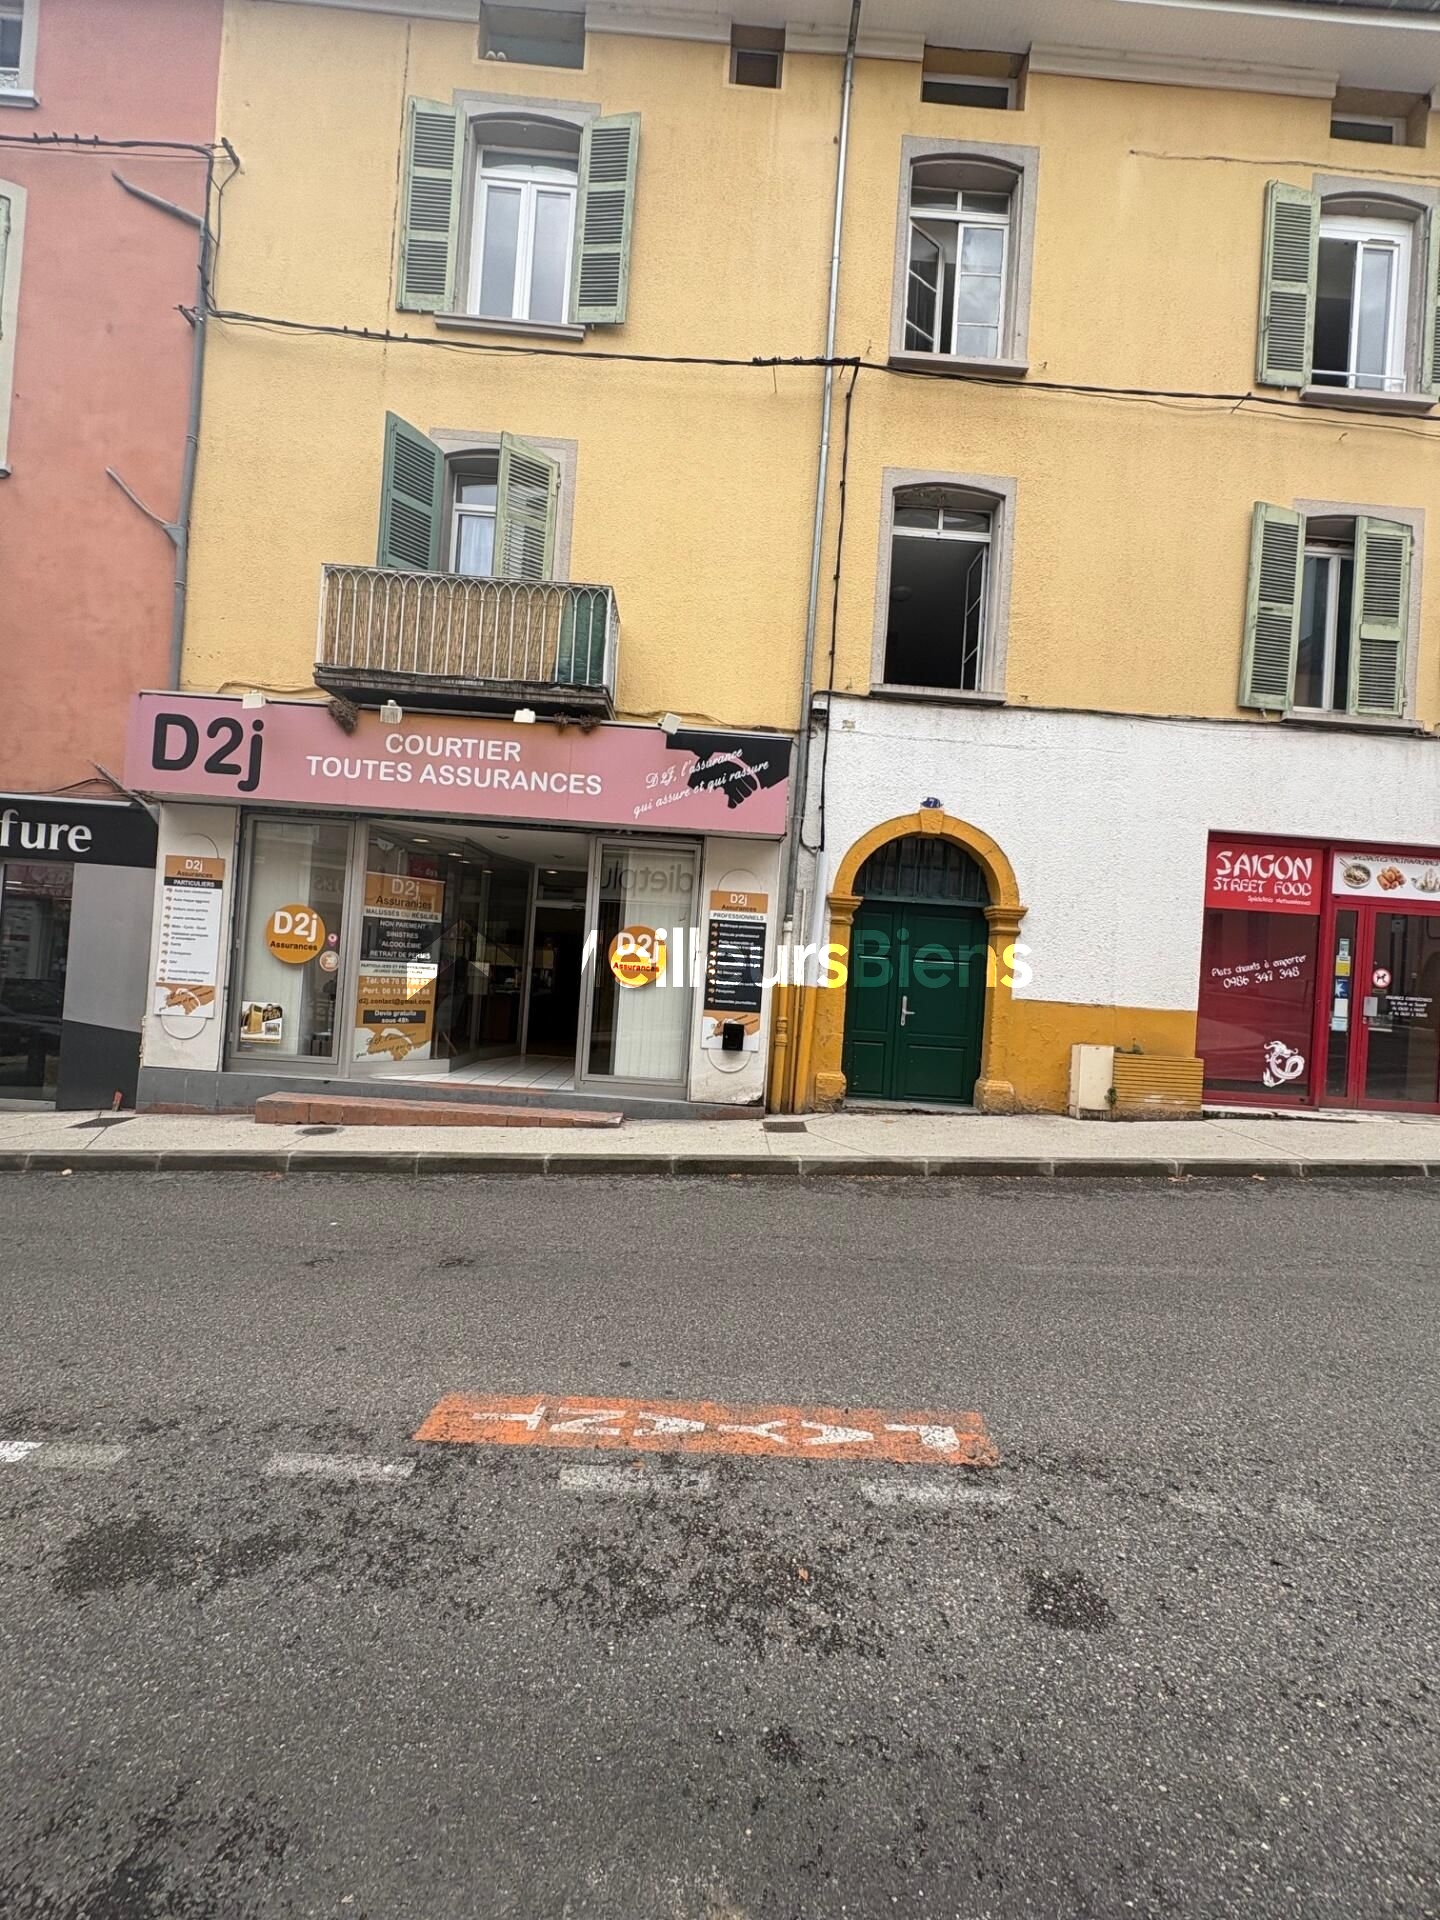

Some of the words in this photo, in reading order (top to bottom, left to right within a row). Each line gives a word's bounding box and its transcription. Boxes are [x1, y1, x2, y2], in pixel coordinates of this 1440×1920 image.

[152, 713, 264, 792] D2j
[385, 733, 521, 762] COURTIER
[306, 755, 413, 783] TOUTES
[419, 763, 602, 795] ASSURANCES
[633, 797, 653, 819] qui
[655, 787, 691, 807] assure
[693, 780, 706, 793] et
[704, 775, 727, 793] qui
[728, 760, 770, 782] rassure
[0, 808, 92, 853] fure
[176, 870, 213, 878] Assurances
[185, 859, 204, 873] D2j
[1215, 850, 1313, 881] SAIGON
[173, 880, 216, 888] PARTICULIERS
[391, 878, 420, 900] D2j
[1213, 876, 1267, 894] STREET
[1273, 881, 1312, 897] FOOD
[375, 895, 433, 910] Assurances
[730, 893, 748, 906] D2j
[273, 910, 318, 943] D2j
[380, 920, 395, 928] NON
[713, 912, 764, 921] PROFESSIONNELS
[386, 930, 419, 939] SINISTRES
[270, 940, 318, 951] Assurances
[369, 949, 397, 959] RETRAIT
[398, 951, 406, 959] DE
[1211, 967, 1232, 977] Plats
[1235, 962, 1261, 974] chauds
[1264, 959, 1270, 969] à
[1272, 954, 1307, 967] emporter
[1223, 975, 1250, 989] 0986
[1254, 970, 1273, 984] 347
[1278, 966, 1300, 980] 348
[471, 1402, 961, 1455] PAYANT
